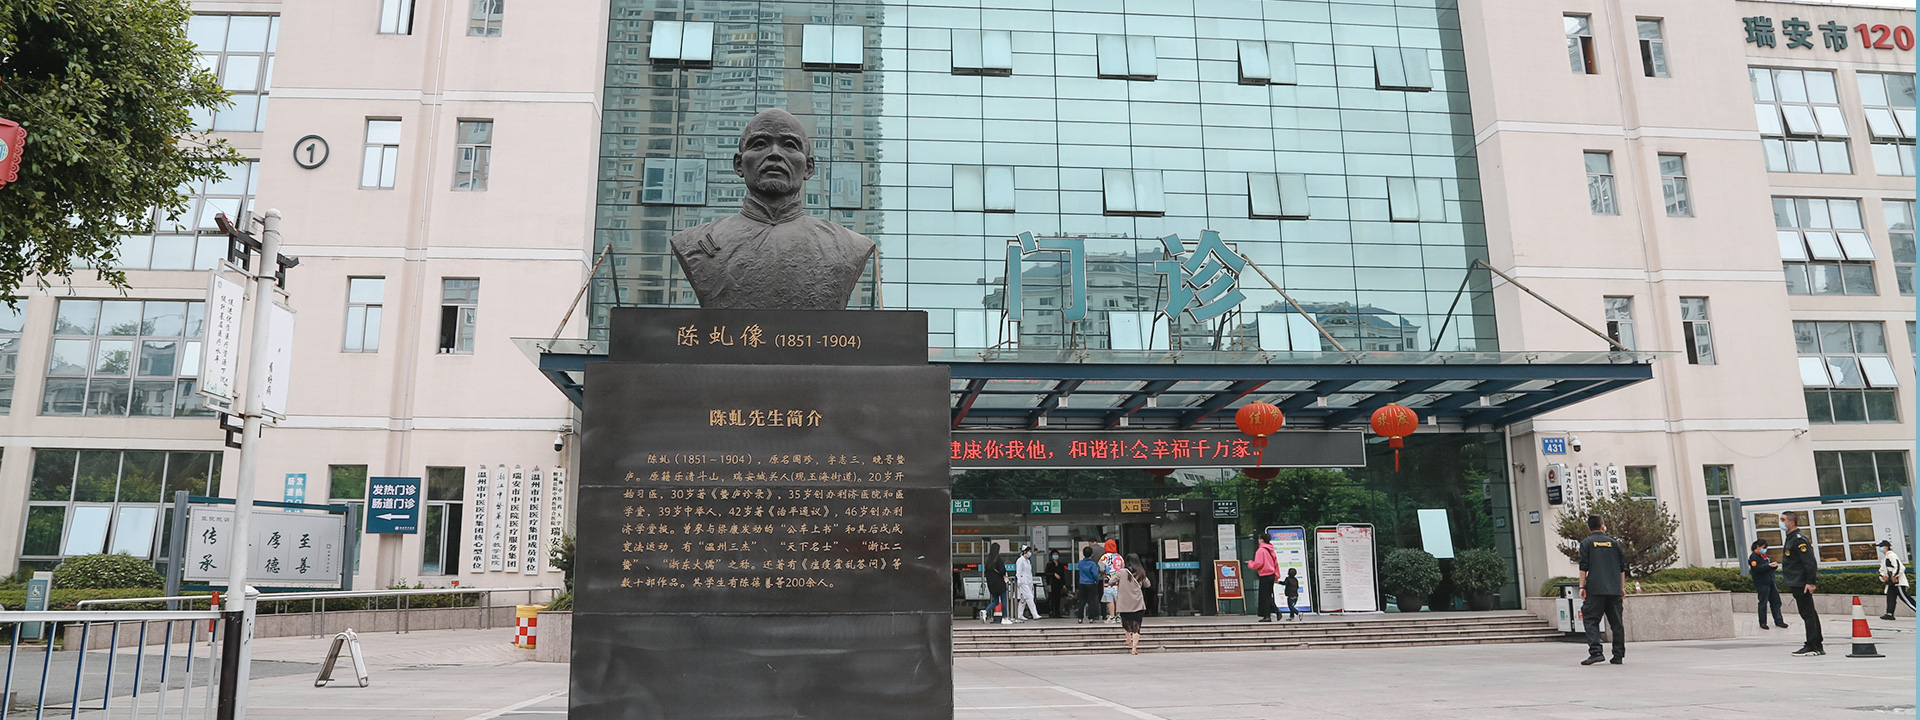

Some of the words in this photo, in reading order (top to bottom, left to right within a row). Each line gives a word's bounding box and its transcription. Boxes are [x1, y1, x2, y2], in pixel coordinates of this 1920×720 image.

[1008, 229, 1248, 324] 门诊
[676, 323, 767, 349] 陈虬像
[708, 408, 823, 427] 陈虬先生简介
[1547, 443, 1563, 453] 431
[371, 498, 416, 510] 肠道门诊
[372, 484, 417, 496] 发热门诊
[507, 472, 522, 568] 瑞安市中医院医疗服务集团
[526, 474, 541, 571] 温州市中医医疗集团成员单位
[199, 527, 218, 572] 传承
[265, 531, 282, 574] 厚德
[295, 533, 312, 574] 至善
